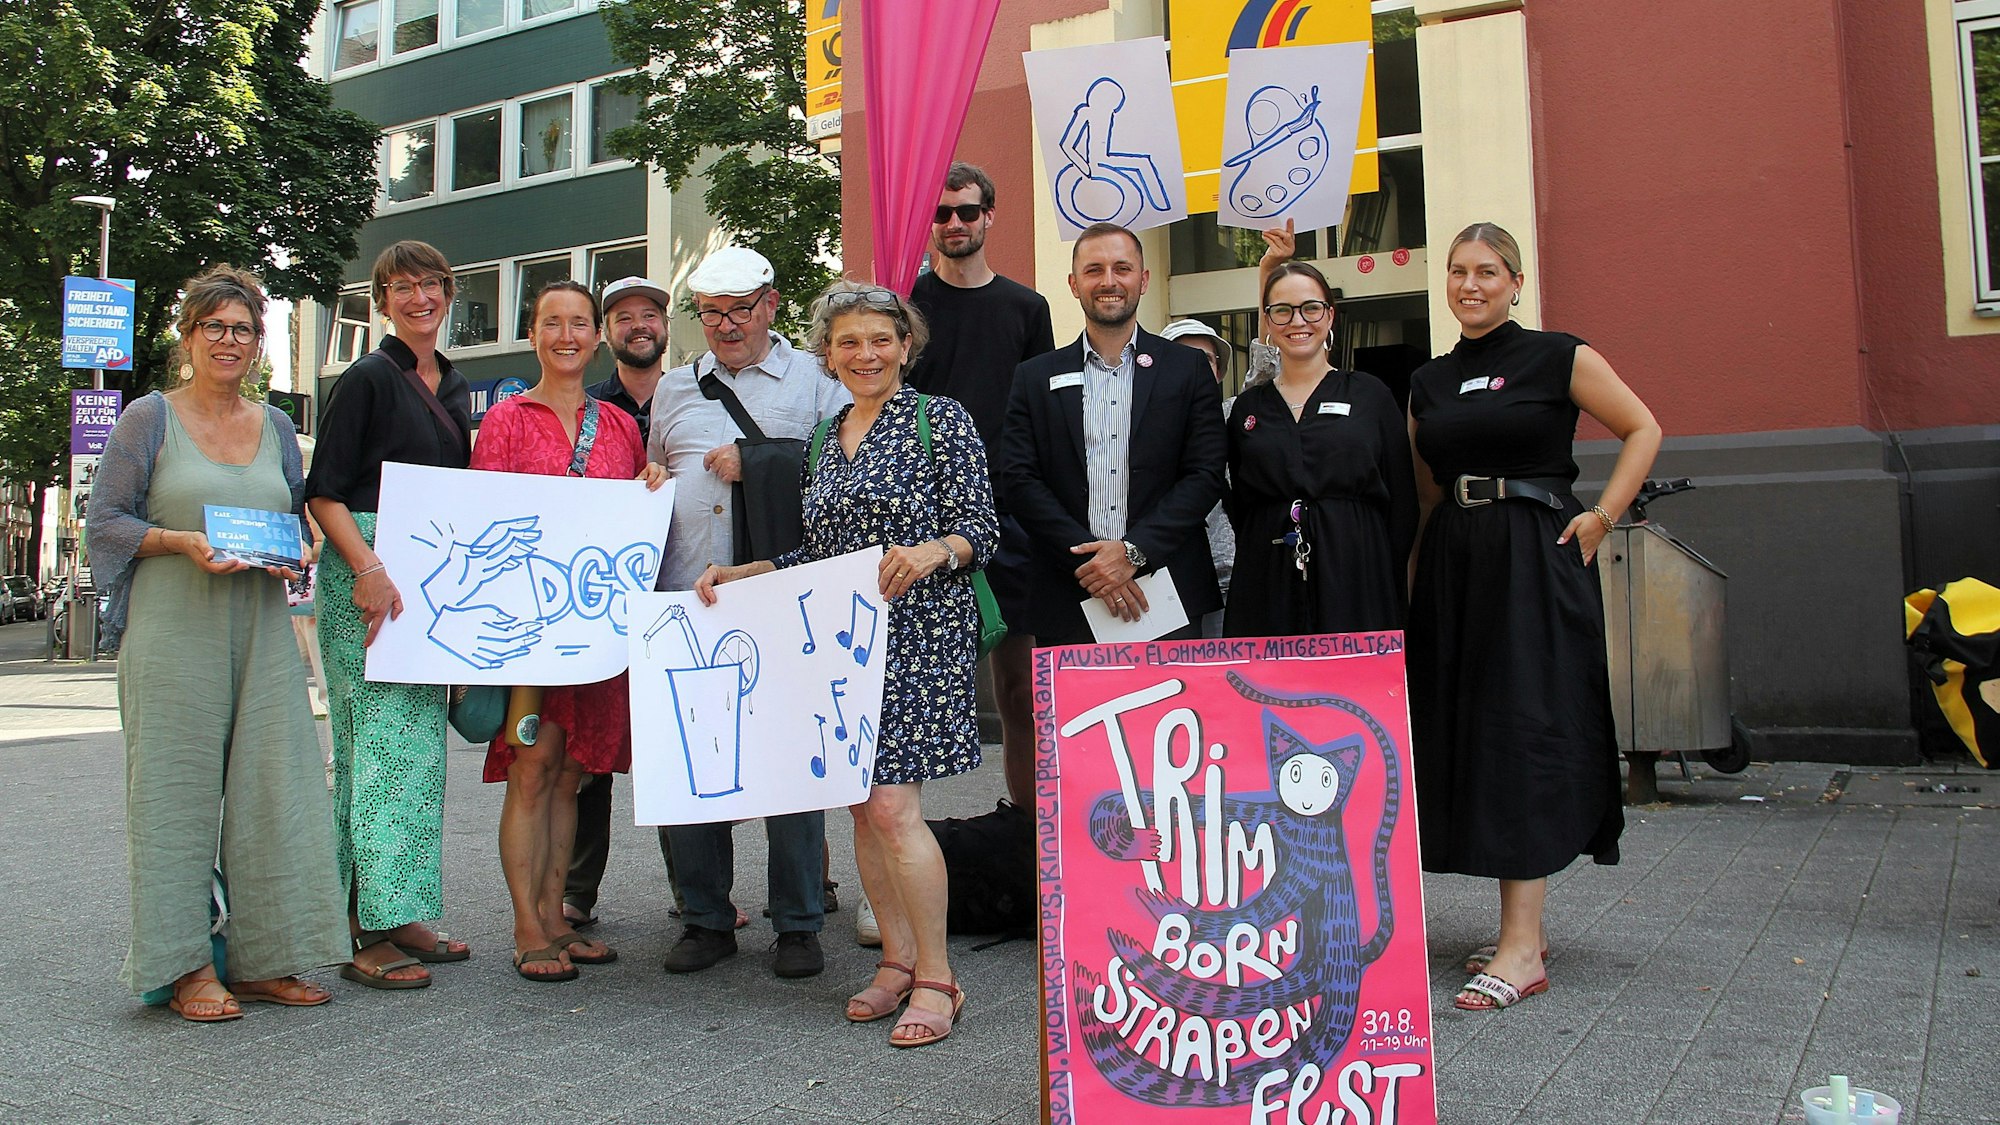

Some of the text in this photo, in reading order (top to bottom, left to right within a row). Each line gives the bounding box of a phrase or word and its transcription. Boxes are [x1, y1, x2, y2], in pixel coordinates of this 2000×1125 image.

[68, 290, 115, 303] FREIHEIT.
[67, 303, 130, 317] WOHLSTAND.
[67, 316, 126, 330] SICHERHEIT.
[67, 336, 116, 346] VERSPRECHEN
[66, 344, 96, 353] HALTEN.
[96, 347, 124, 360] AfD
[76, 395, 117, 407] KEINE
[76, 407, 116, 416] ZEIT FÜR
[76, 415, 116, 425] FAXEN
[526, 541, 660, 636] DGS
[1058, 645, 1140, 670] MUSIK.
[1362, 1008, 1415, 1035] 31.8.
[1360, 1035, 1401, 1051] 11-19
